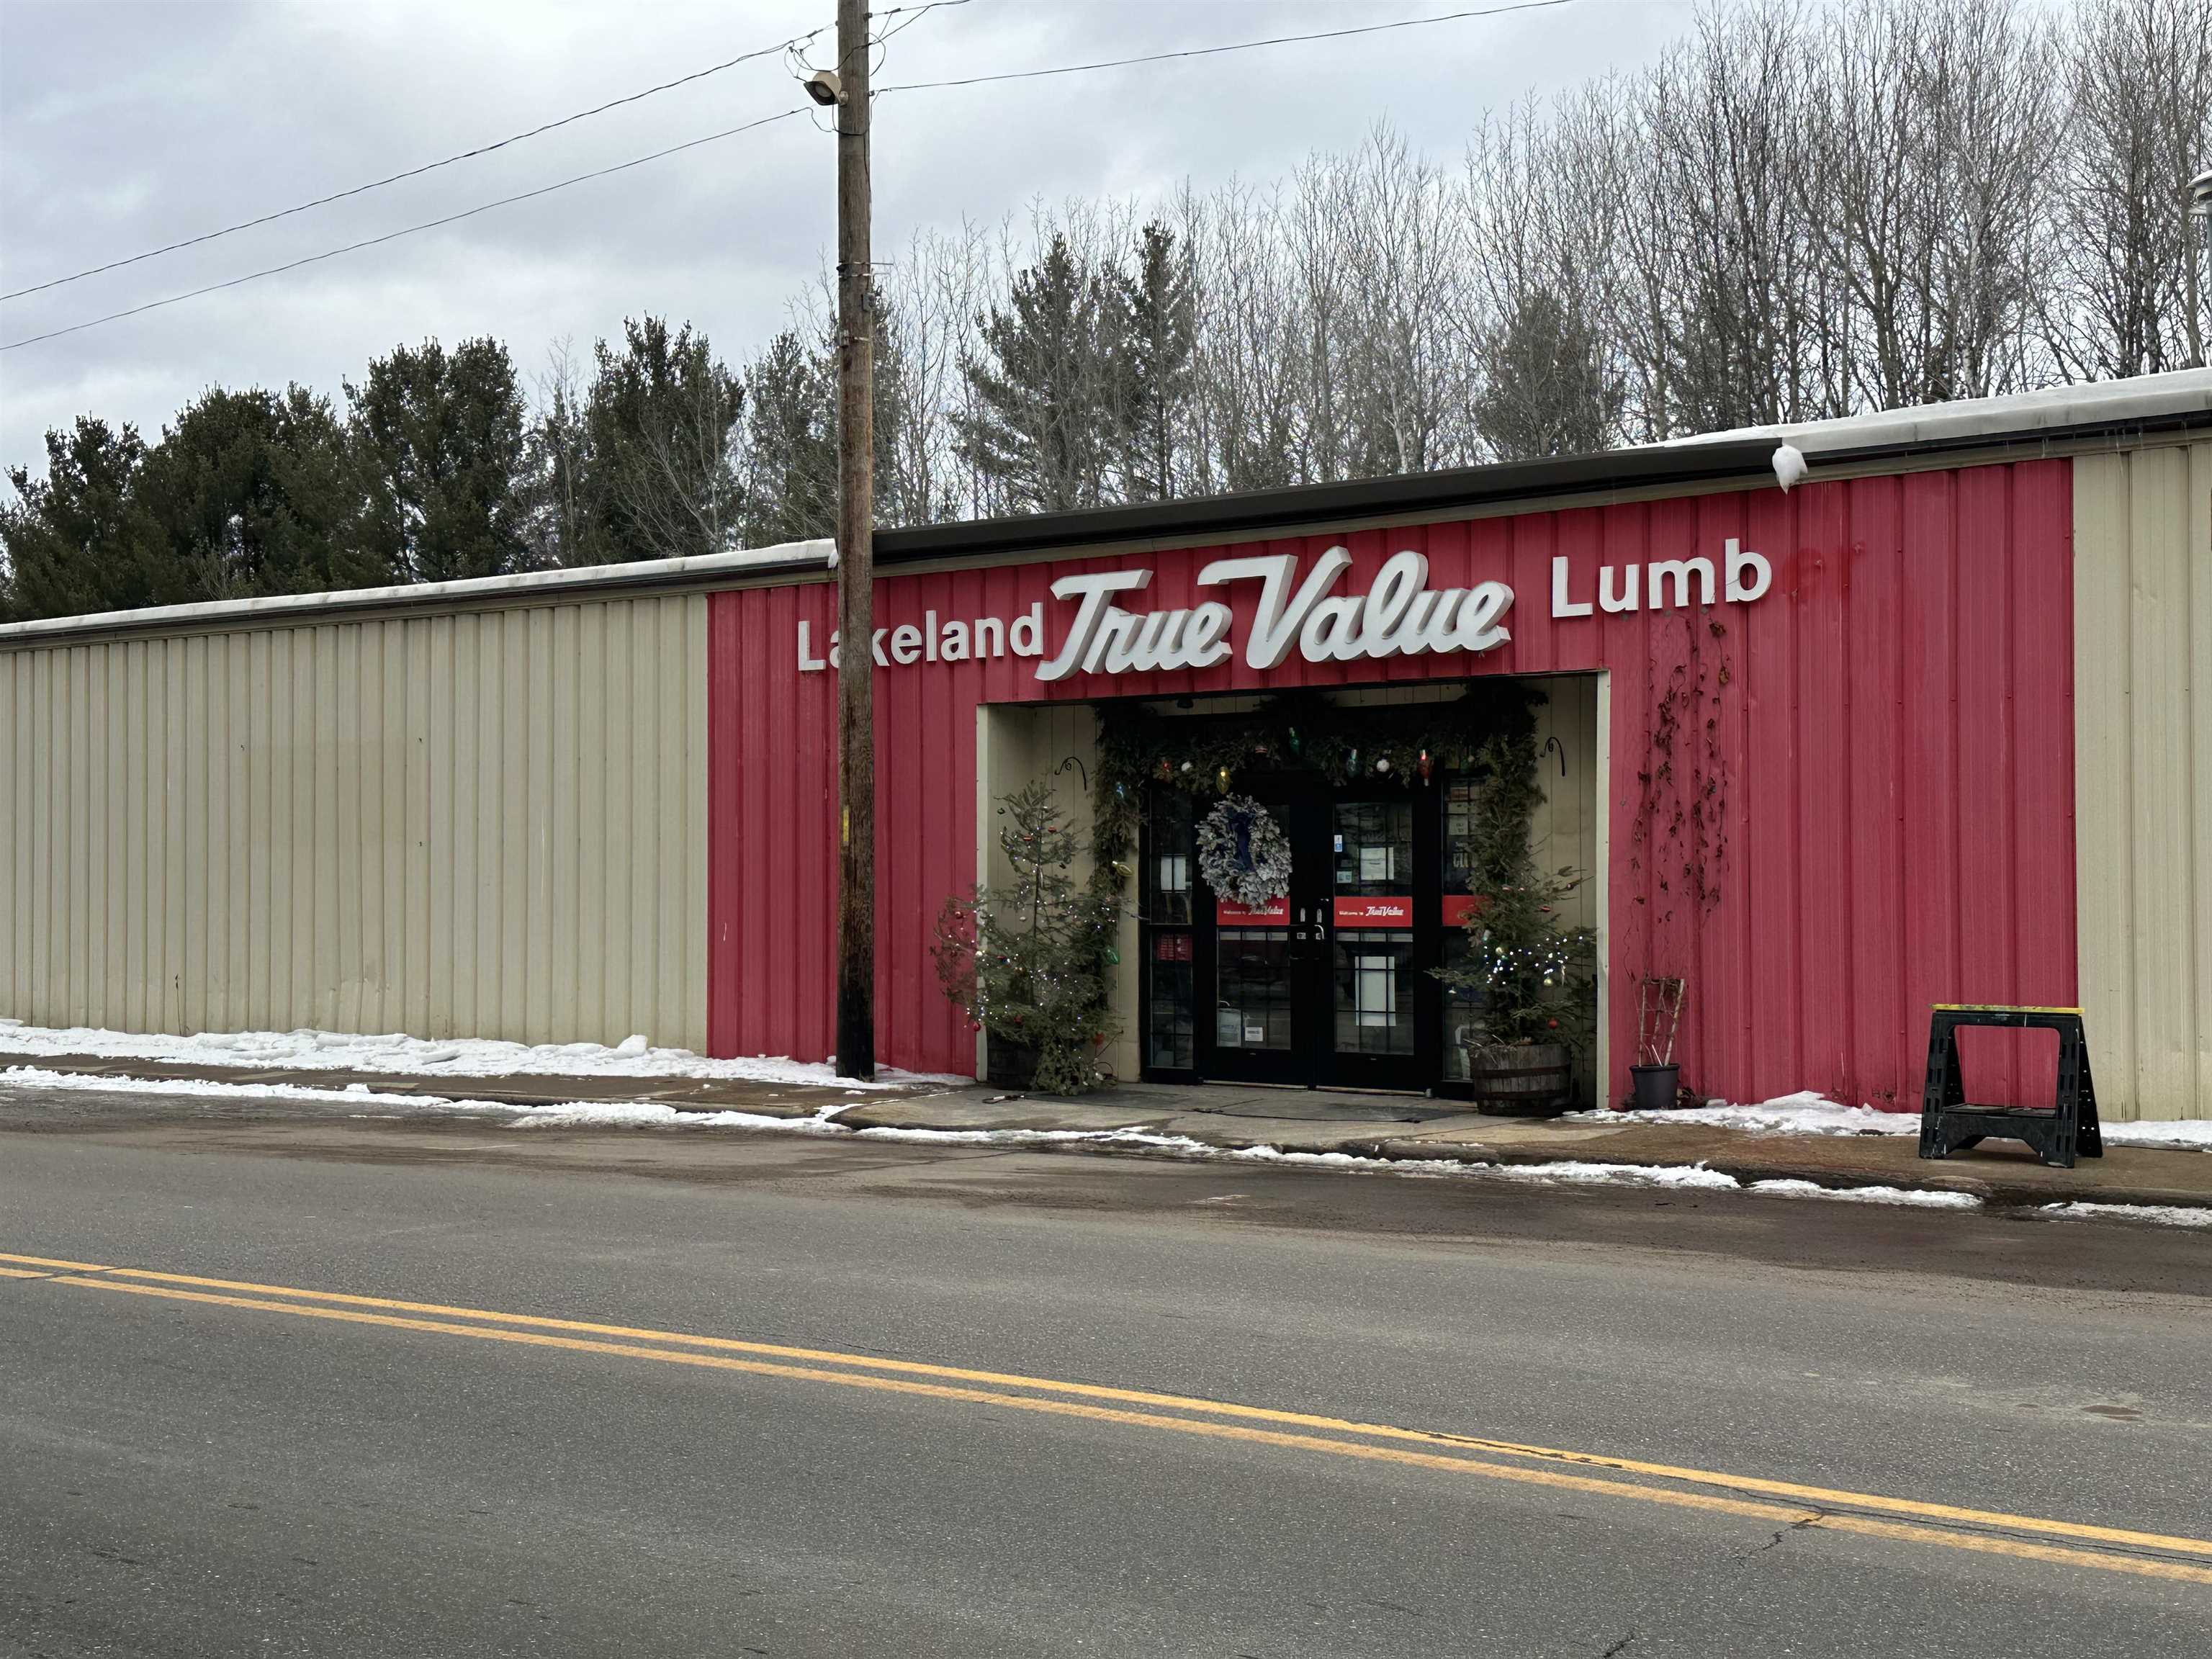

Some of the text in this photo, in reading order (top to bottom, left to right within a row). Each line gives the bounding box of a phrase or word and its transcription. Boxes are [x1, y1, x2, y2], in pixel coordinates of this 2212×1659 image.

[1034, 569, 1233, 681] True
[1197, 546, 1514, 670] Value
[1552, 539, 1772, 617] Lumb
